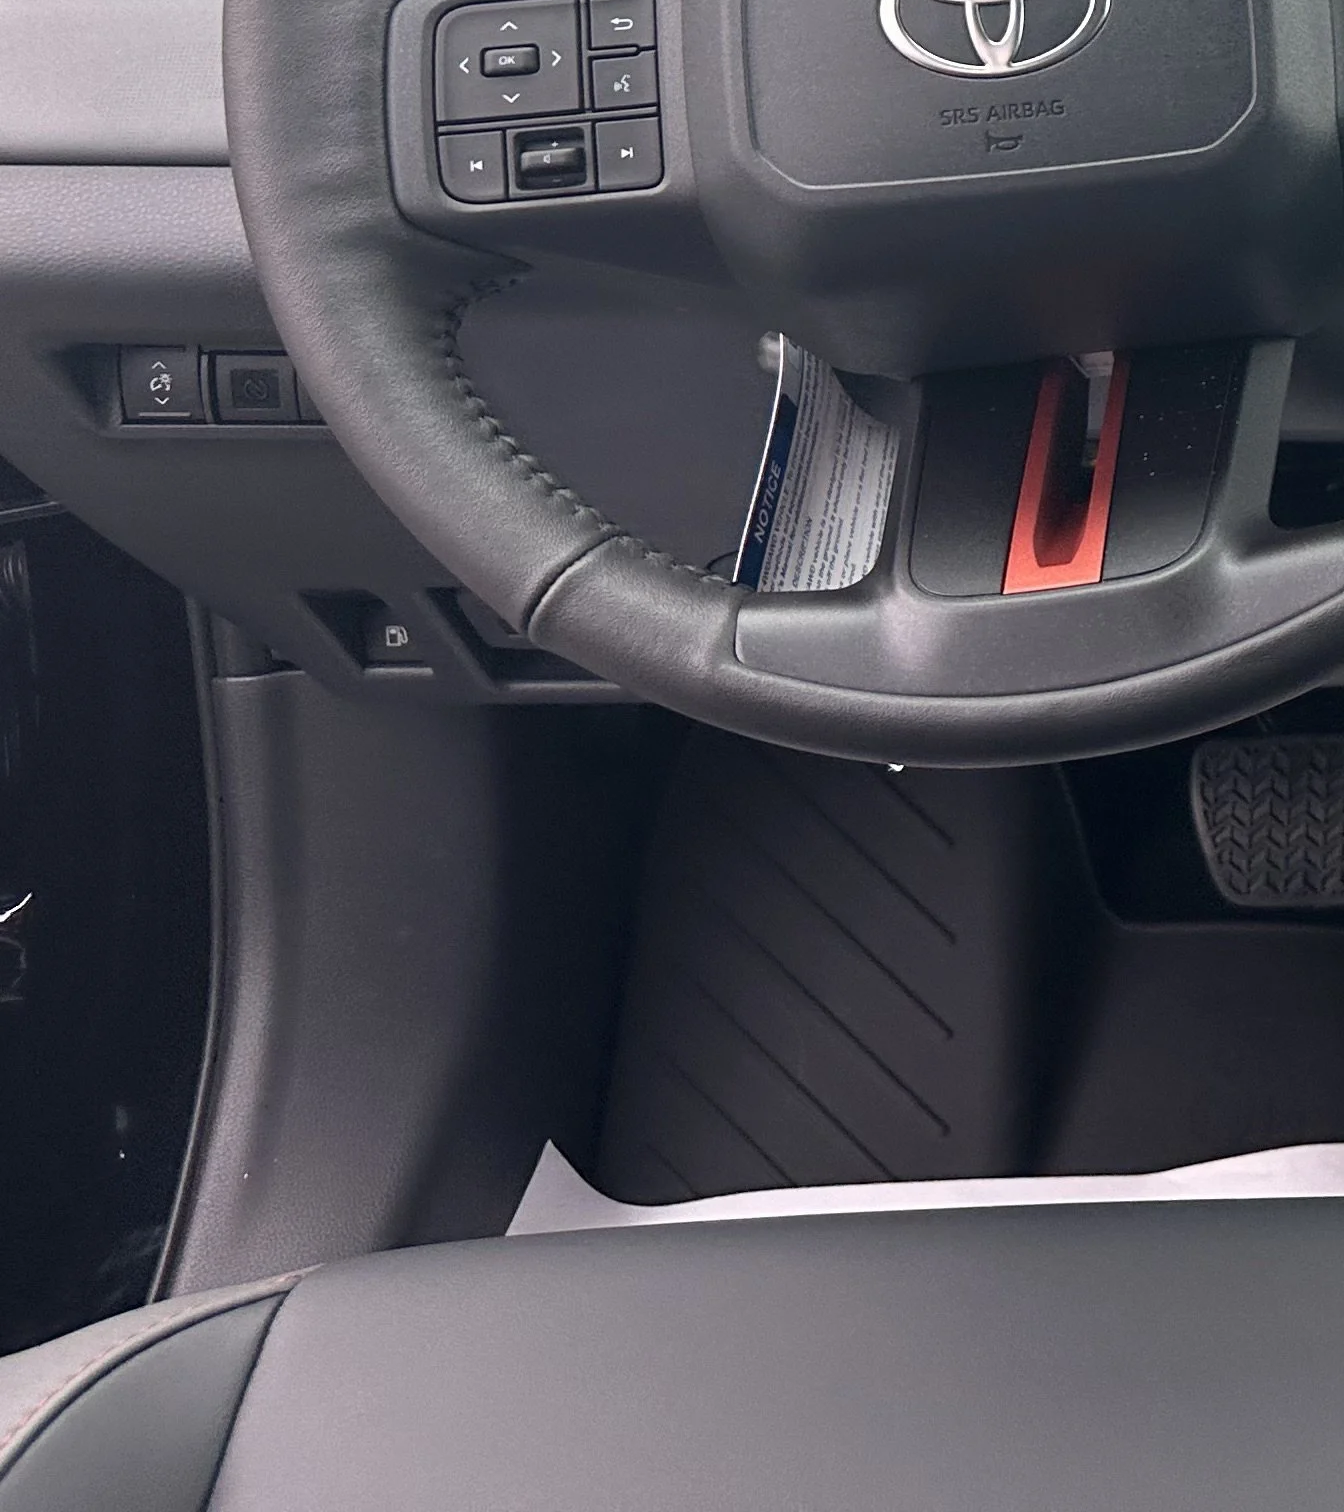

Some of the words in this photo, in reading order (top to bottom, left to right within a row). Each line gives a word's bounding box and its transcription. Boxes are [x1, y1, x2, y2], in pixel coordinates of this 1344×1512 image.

[498, 55, 516, 65] OK
[939, 108, 979, 126] SRS
[986, 99, 1065, 122] AIRBAG
[754, 458, 783, 544] NOTICE
